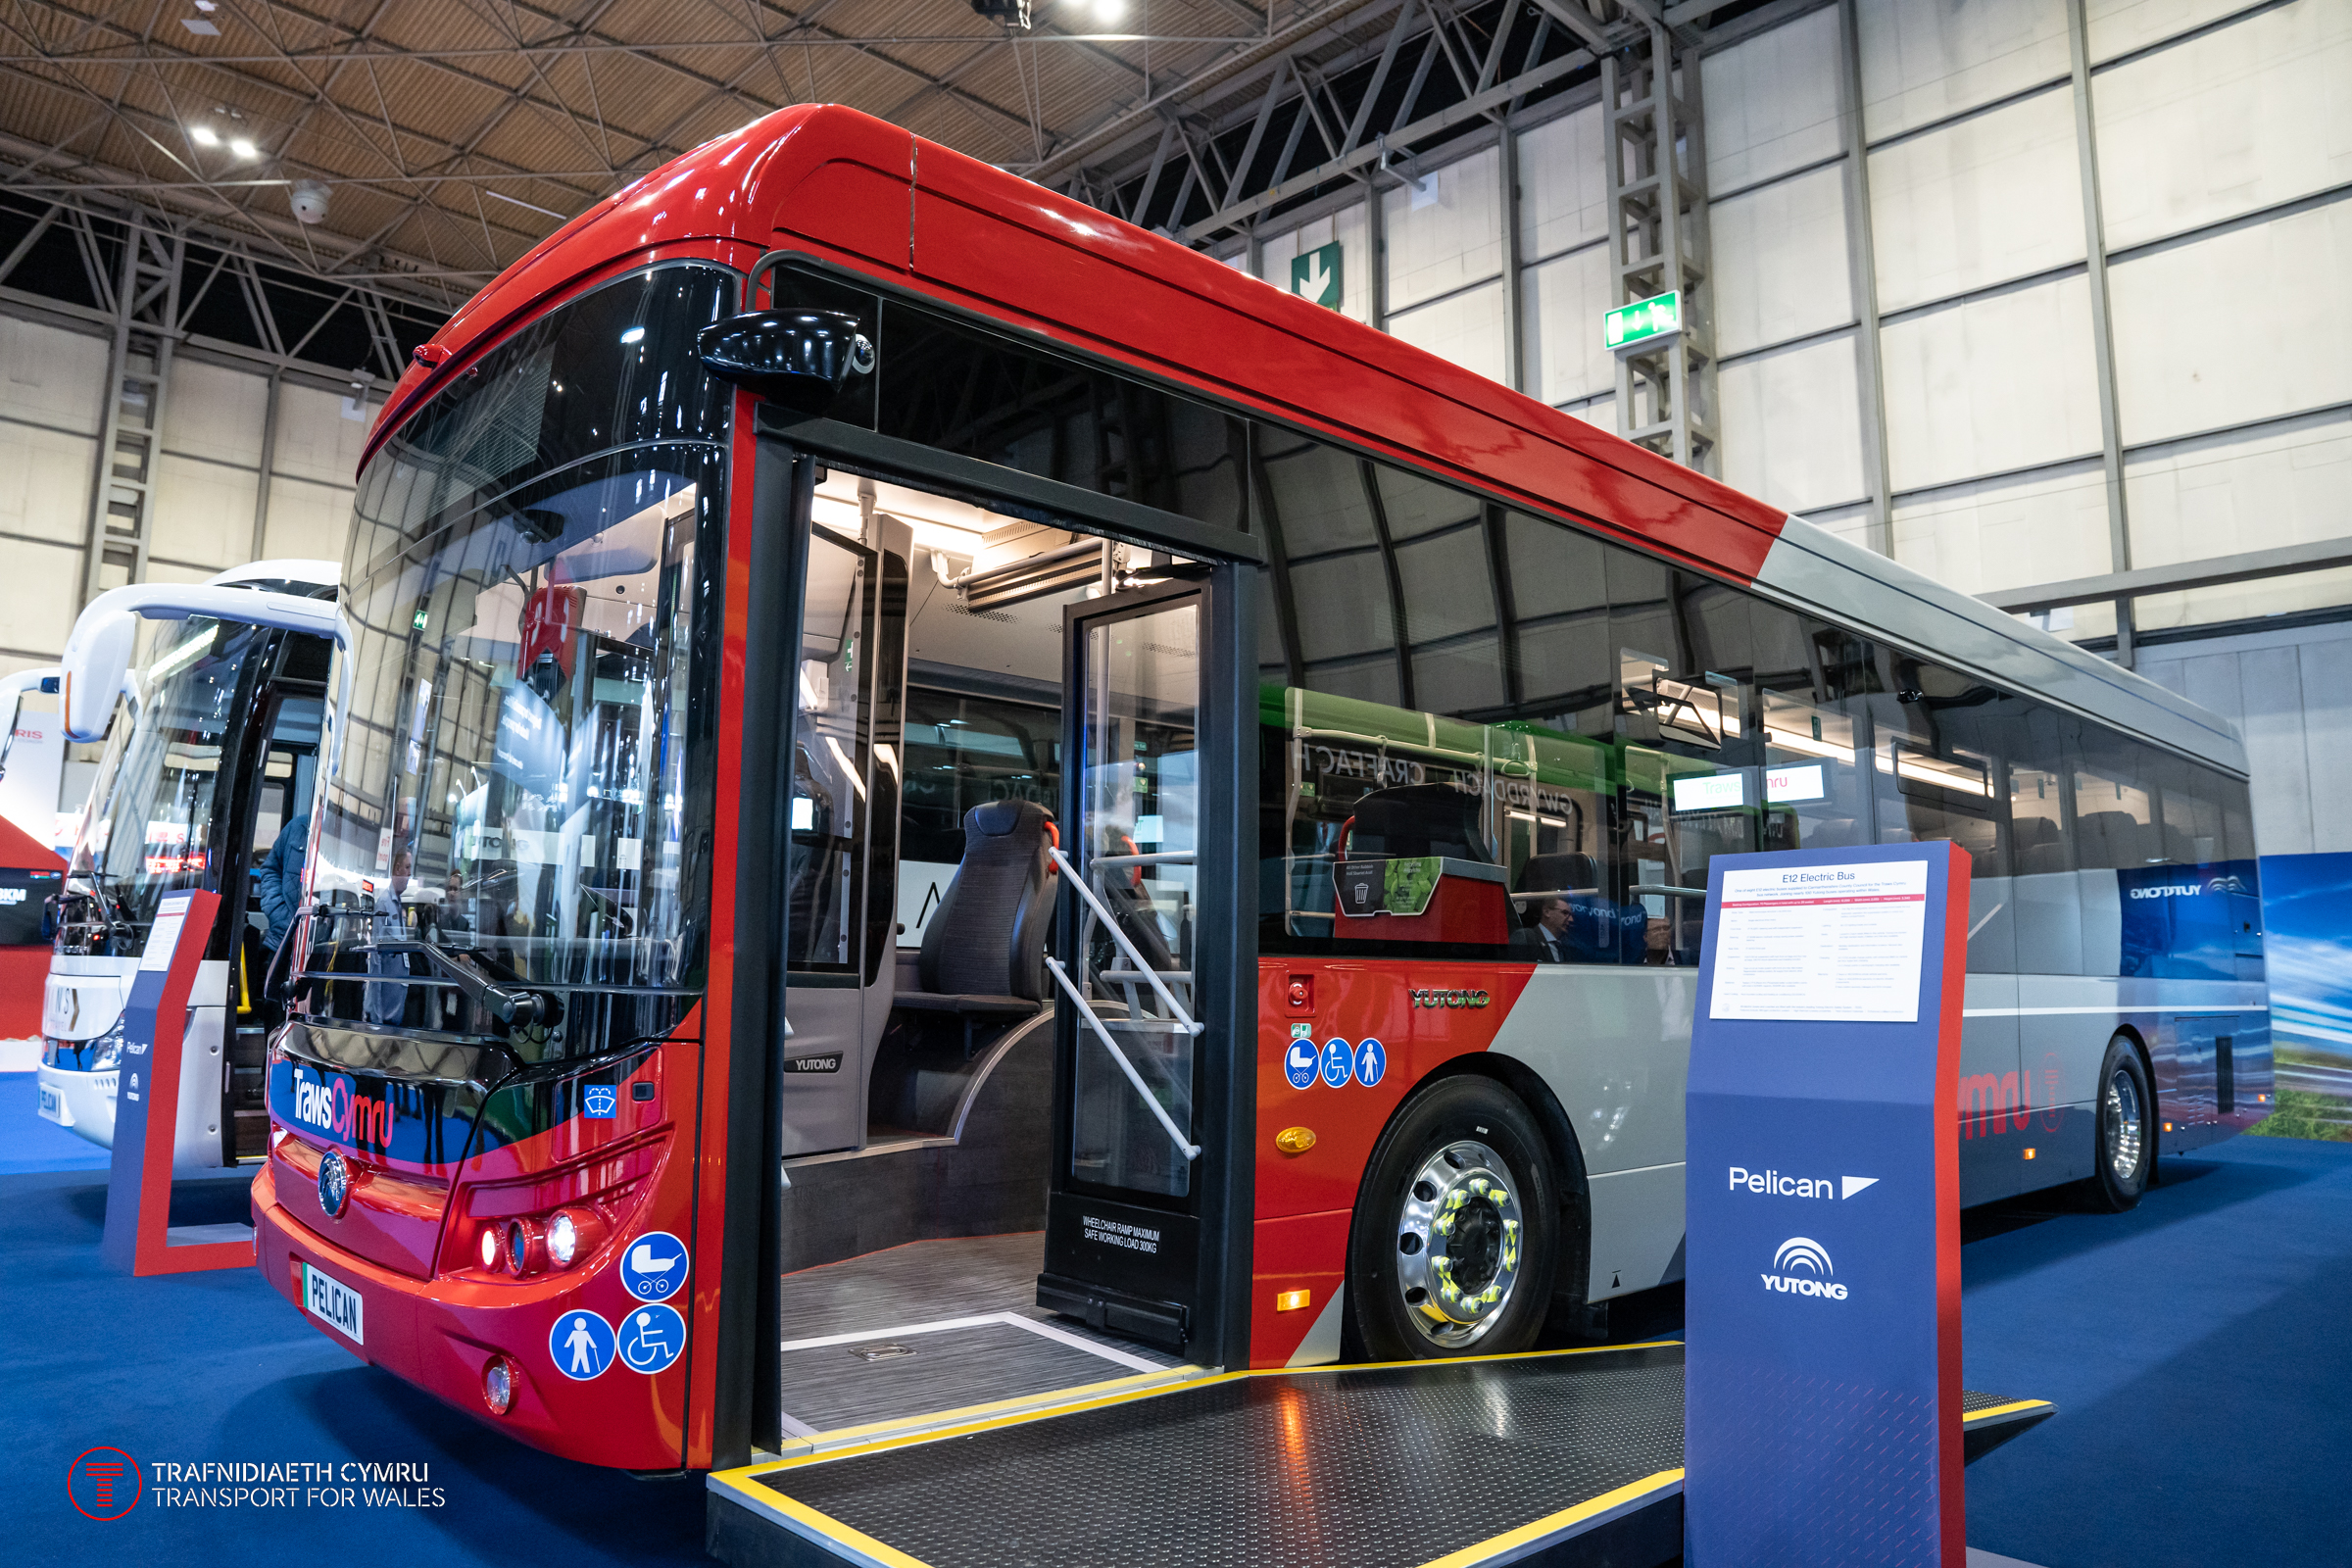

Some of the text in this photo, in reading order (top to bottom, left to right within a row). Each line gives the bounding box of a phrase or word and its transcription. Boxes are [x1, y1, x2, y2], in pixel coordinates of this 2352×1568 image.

[1783, 871, 1855, 883] E12 Electric Bus
[1408, 989, 1490, 1009] YUTONG
[796, 1058, 836, 1070] YUTONG
[294, 1068, 394, 1148] TrawsCymru
[1730, 1167, 1833, 1200] Pelican
[1083, 1215, 1160, 1242] WHEELCHAIR RAMP MAXIMUM
[1084, 1228, 1156, 1253] SAFE WORKING LOAD 300KG
[1761, 1274, 1847, 1300] YUTONG
[313, 1274, 357, 1334] PELICAN
